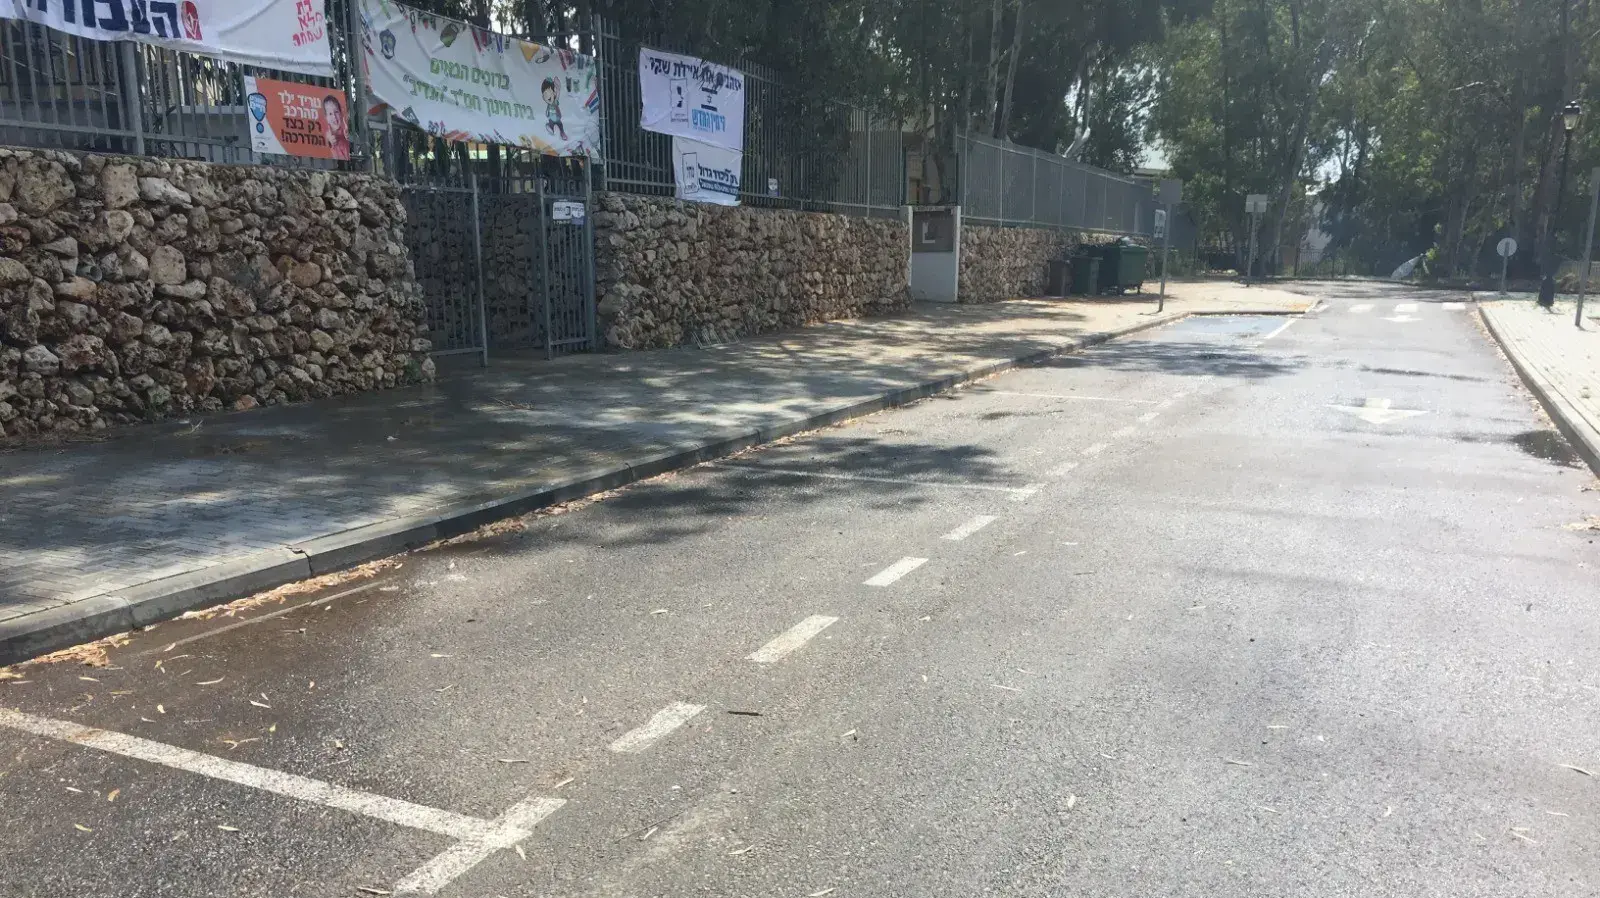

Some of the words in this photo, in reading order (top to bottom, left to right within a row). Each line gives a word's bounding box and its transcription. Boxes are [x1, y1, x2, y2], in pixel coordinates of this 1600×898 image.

[277, 89, 295, 105] ילד
[283, 104, 319, 121] מהרכב
[282, 116, 305, 130] בצד
[307, 119, 322, 134] רק
[280, 128, 326, 146] המדרכה!
